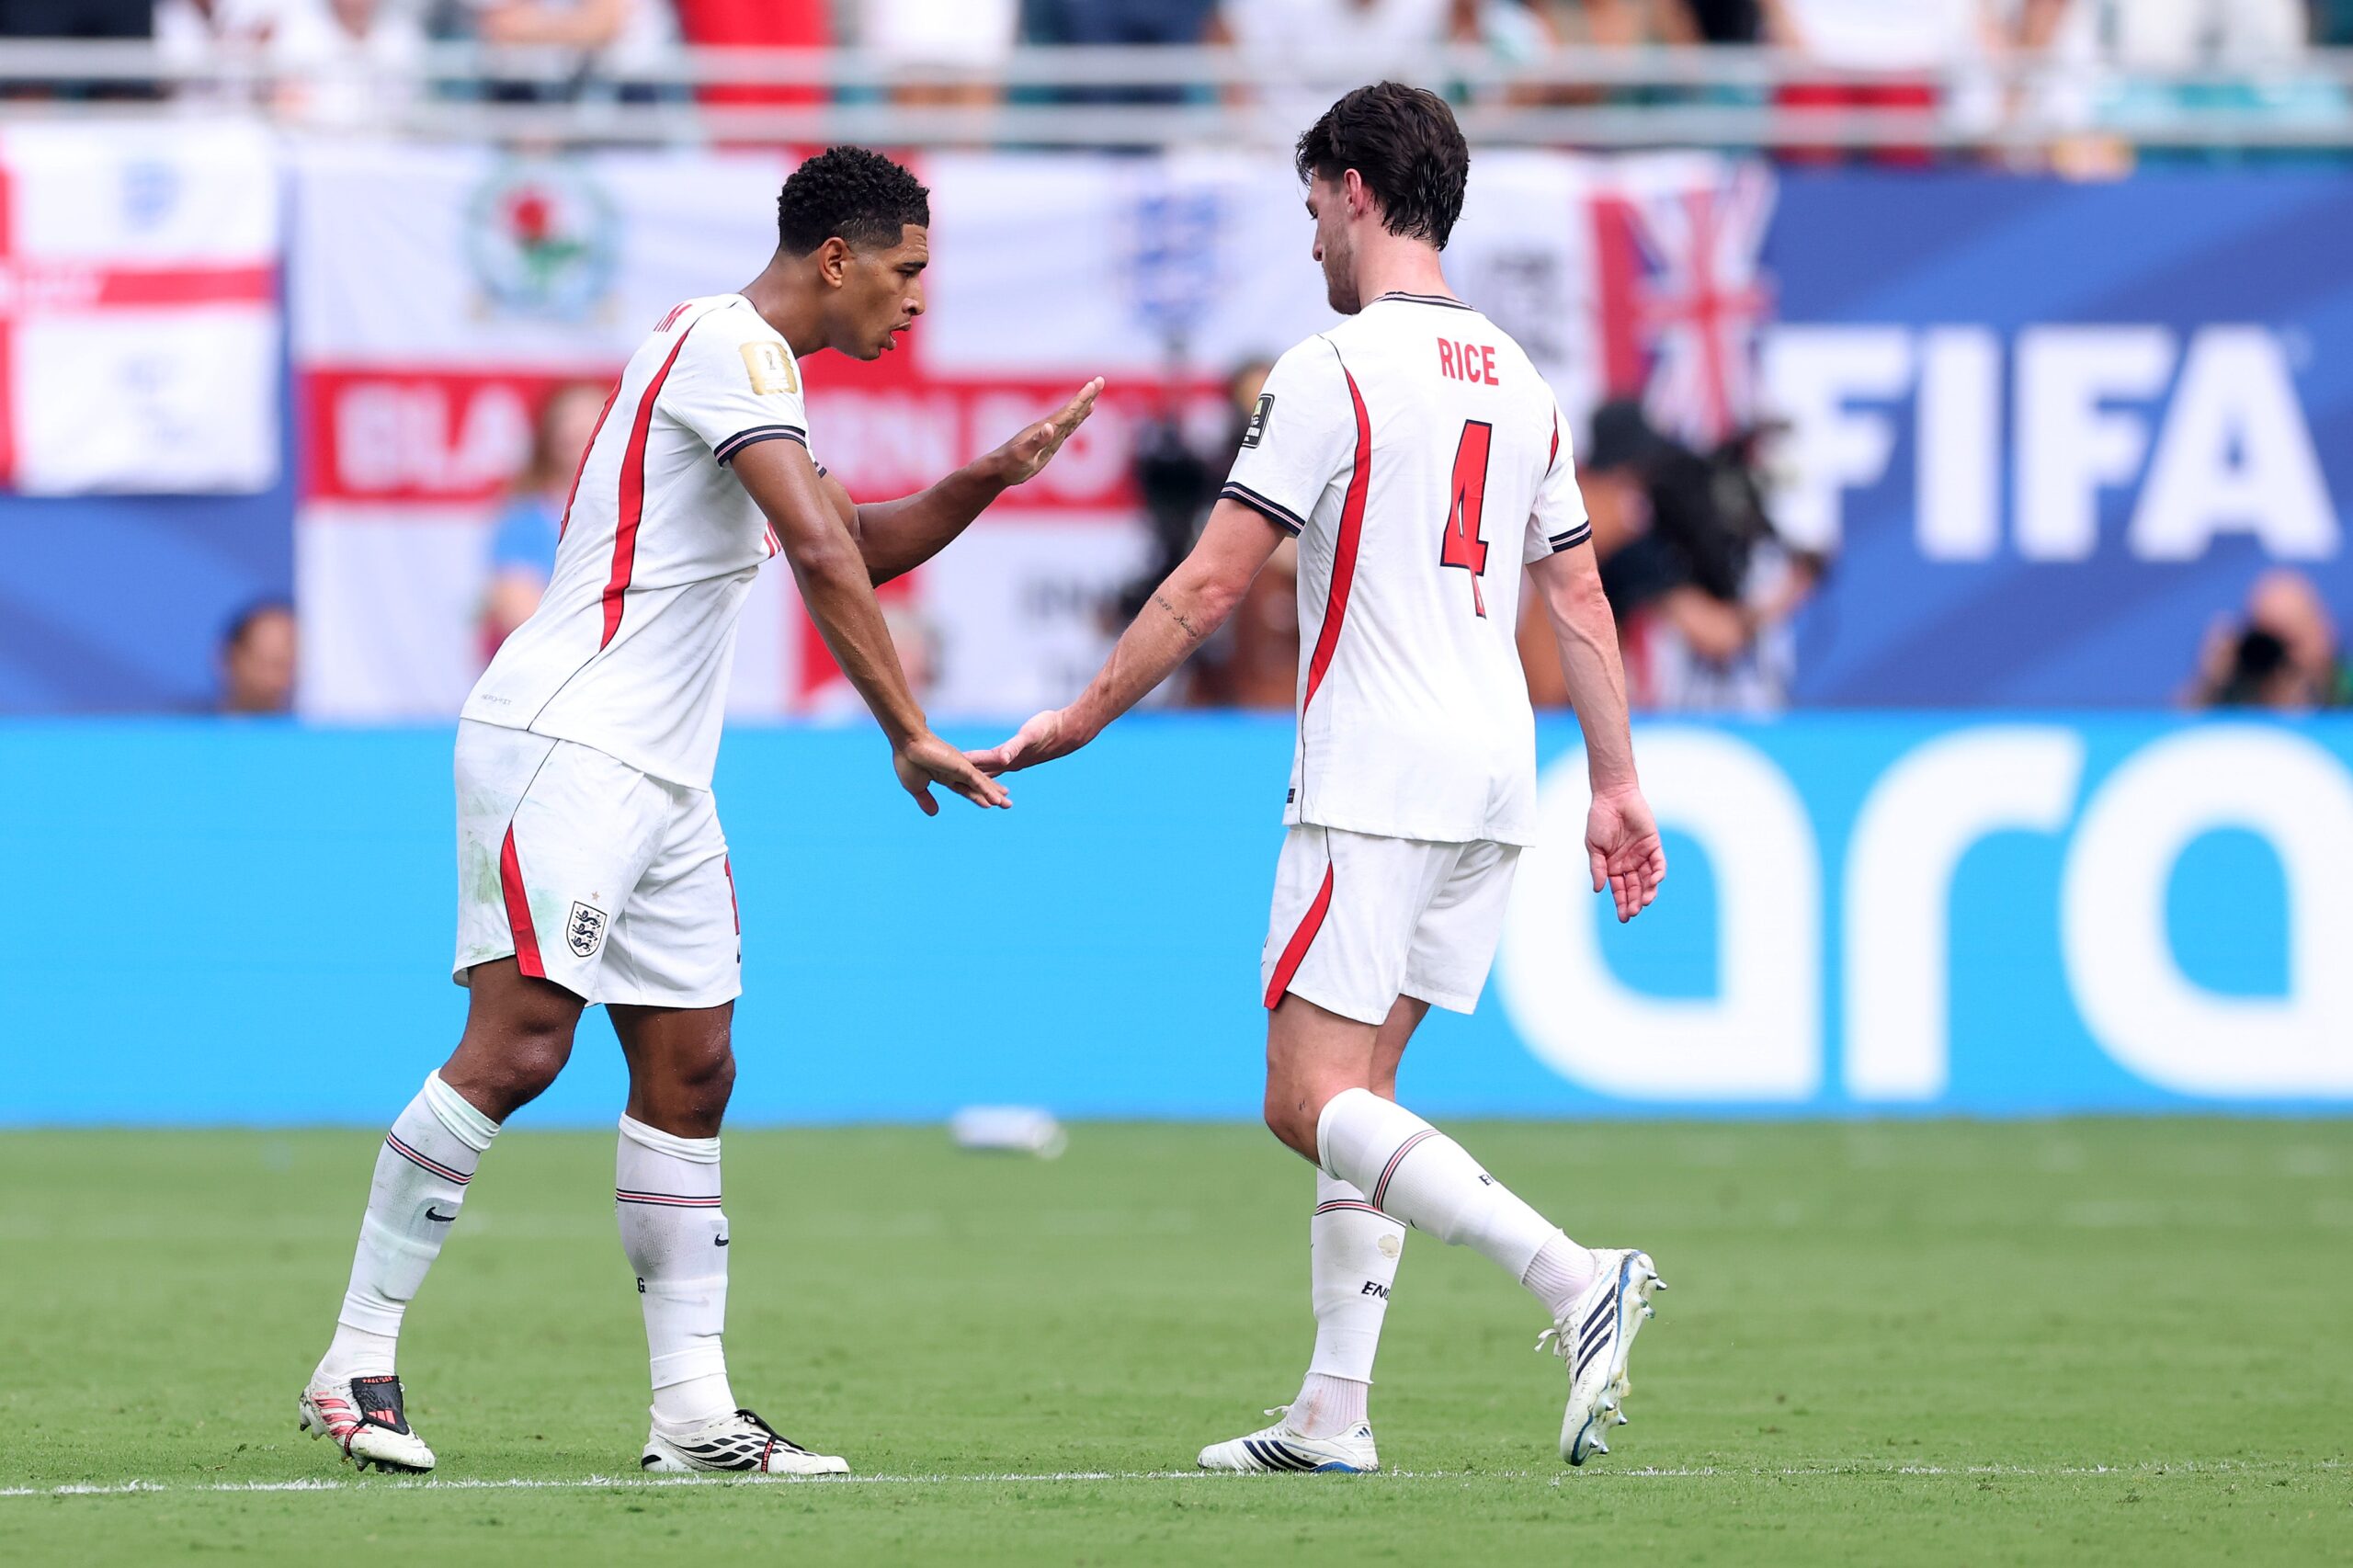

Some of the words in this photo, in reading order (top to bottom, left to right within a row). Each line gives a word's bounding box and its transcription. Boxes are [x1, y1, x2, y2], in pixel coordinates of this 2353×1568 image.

[1437, 336, 1499, 386] RICE
[1763, 324, 2339, 559] FIFA
[1439, 418, 1493, 619] 4
